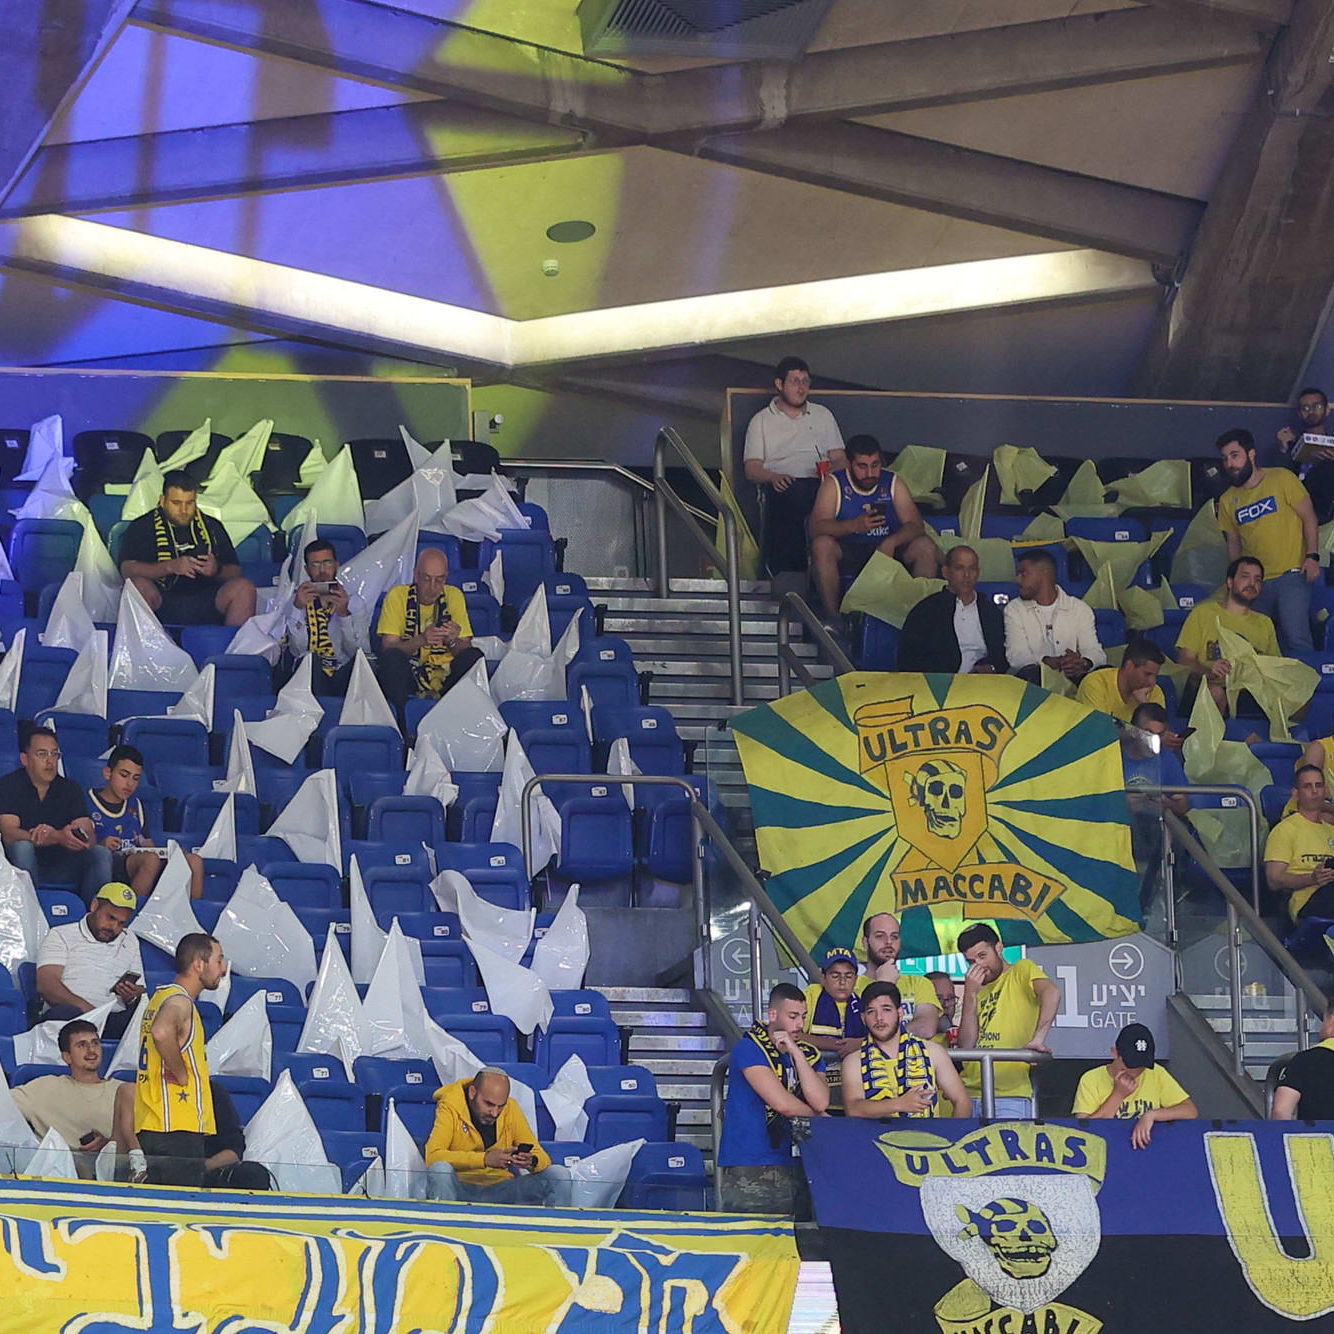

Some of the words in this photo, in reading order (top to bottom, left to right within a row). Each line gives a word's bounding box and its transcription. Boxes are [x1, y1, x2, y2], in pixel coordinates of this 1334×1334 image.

[1237, 500, 1274, 522] FOX
[861, 716, 1006, 763] ULTRAS
[900, 873, 1053, 913] MACCABI
[827, 948, 851, 959] MTA
[1090, 984, 1147, 1007] יציע
[1091, 1011, 1137, 1028] GATE
[905, 1130, 1088, 1175] ULTRAS
